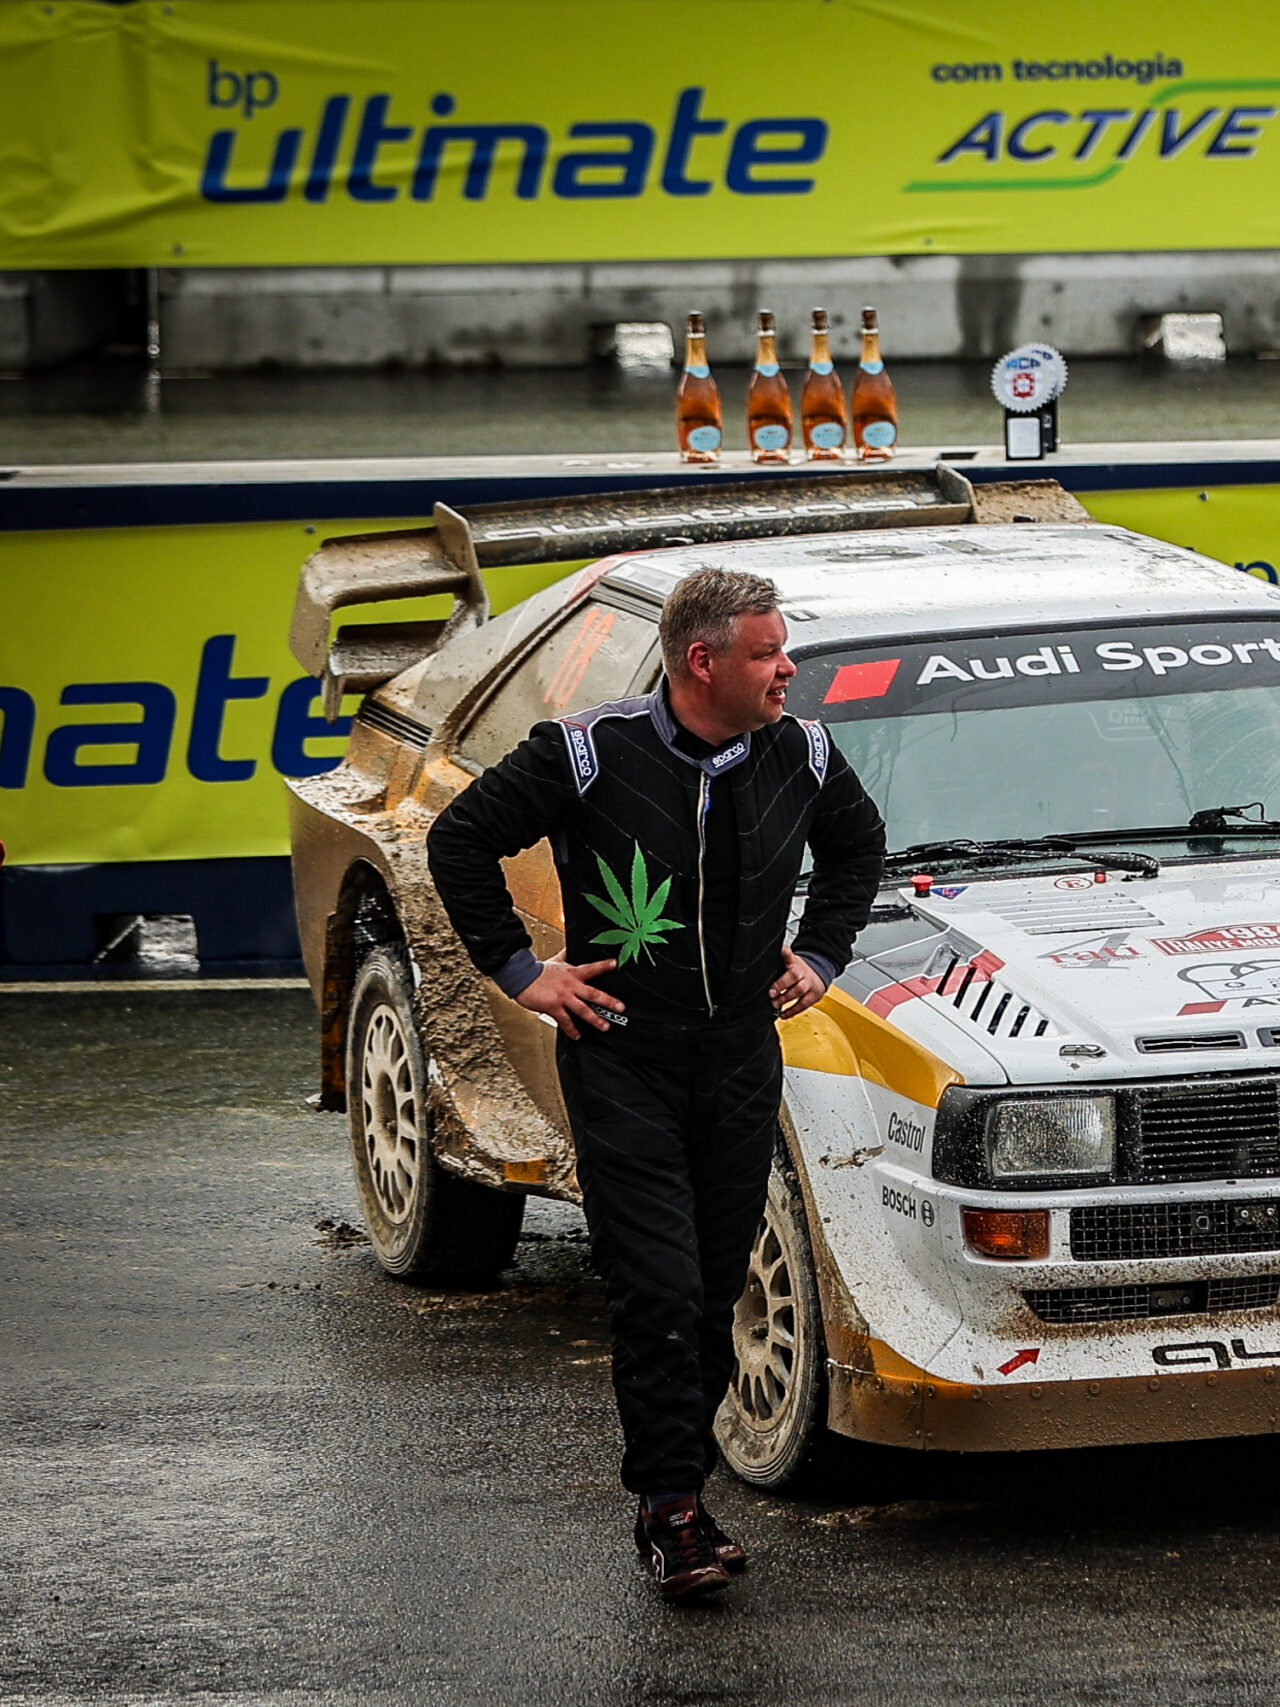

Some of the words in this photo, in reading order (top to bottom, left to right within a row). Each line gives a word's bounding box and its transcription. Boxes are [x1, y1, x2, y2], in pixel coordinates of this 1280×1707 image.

[208, 60, 279, 118] bp
[929, 60, 1002, 83] com
[1012, 53, 1183, 86] tecnologia
[200, 87, 830, 205] ultimate
[936, 105, 1279, 166] ACTIVE
[916, 645, 1081, 685] Audi
[712, 742, 746, 769] sparco
[1170, 938, 1234, 952] RALLYE
[888, 1112, 926, 1153] Castrol
[882, 1185, 917, 1220] BOSCH
